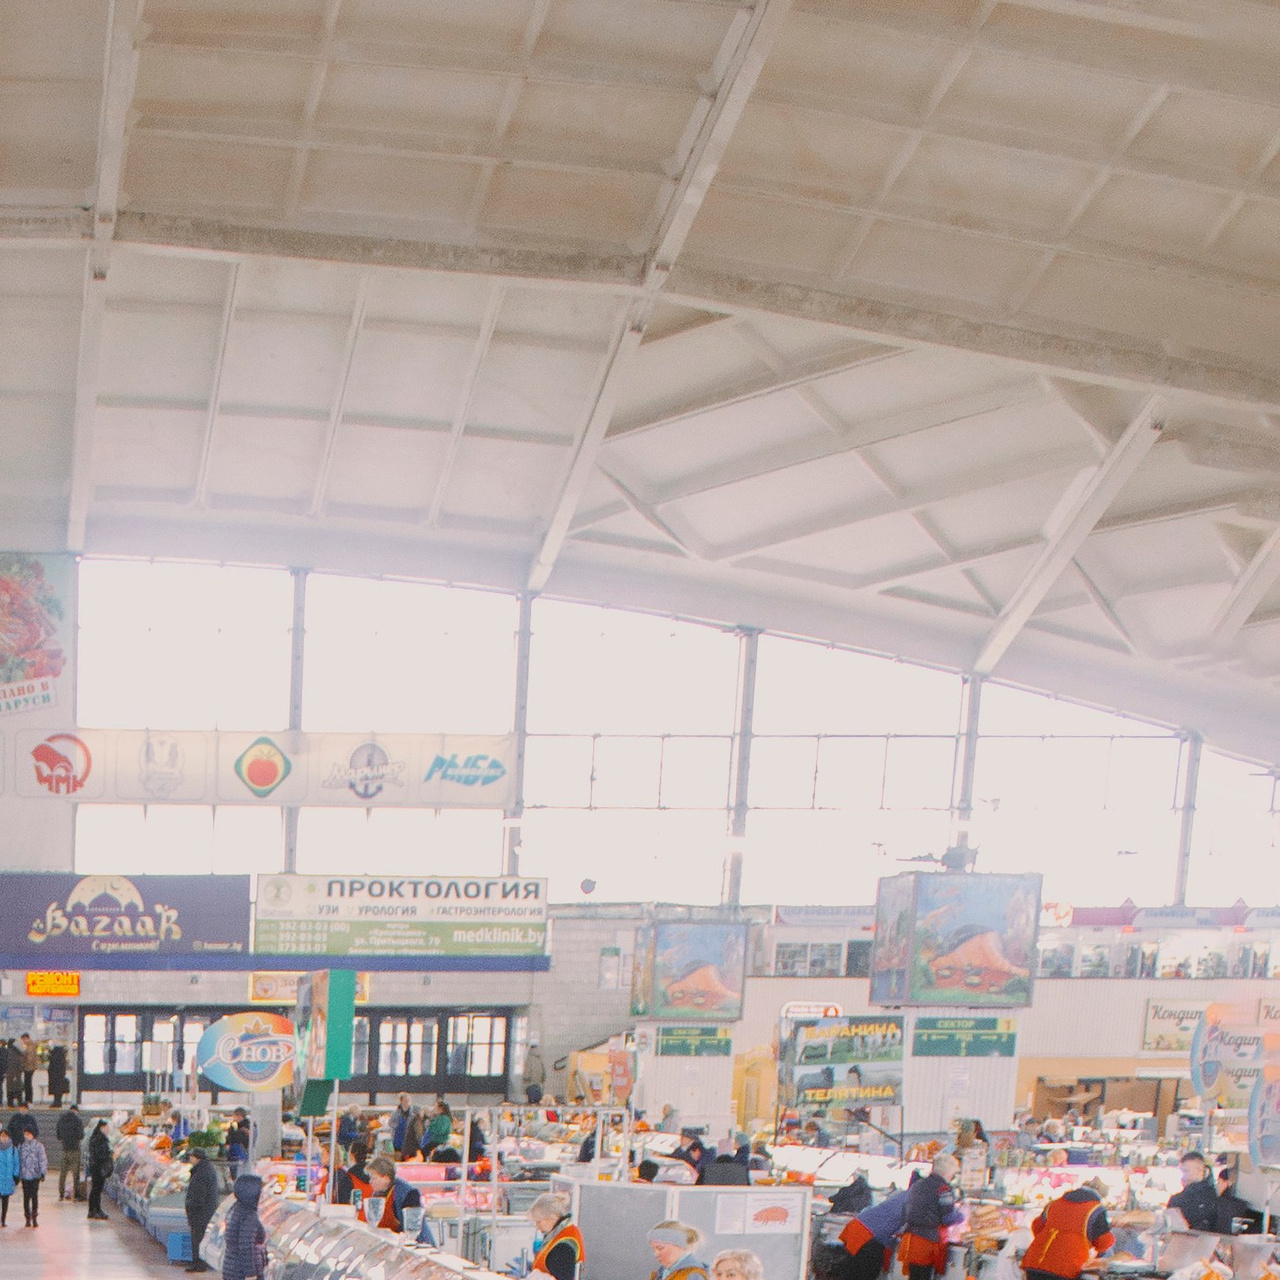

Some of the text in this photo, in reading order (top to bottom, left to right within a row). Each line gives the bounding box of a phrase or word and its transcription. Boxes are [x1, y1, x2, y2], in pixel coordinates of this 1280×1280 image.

[326, 879, 541, 900] ПРОКТОЛОГИЯ
[318, 904, 340, 916] УЗИ
[358, 904, 418, 916] УРОЛОГИЯ
[436, 906, 544, 917] ГАСТРОЭНТЕРОЛОГИЯ
[453, 931, 545, 947] medklinik.by
[27, 971, 80, 985] РЕМОНТ
[806, 1022, 900, 1039] БАРАНИНА
[936, 1019, 976, 1029] СЕКТОР
[806, 1086, 895, 1101] ТЕЛЯТИНА
